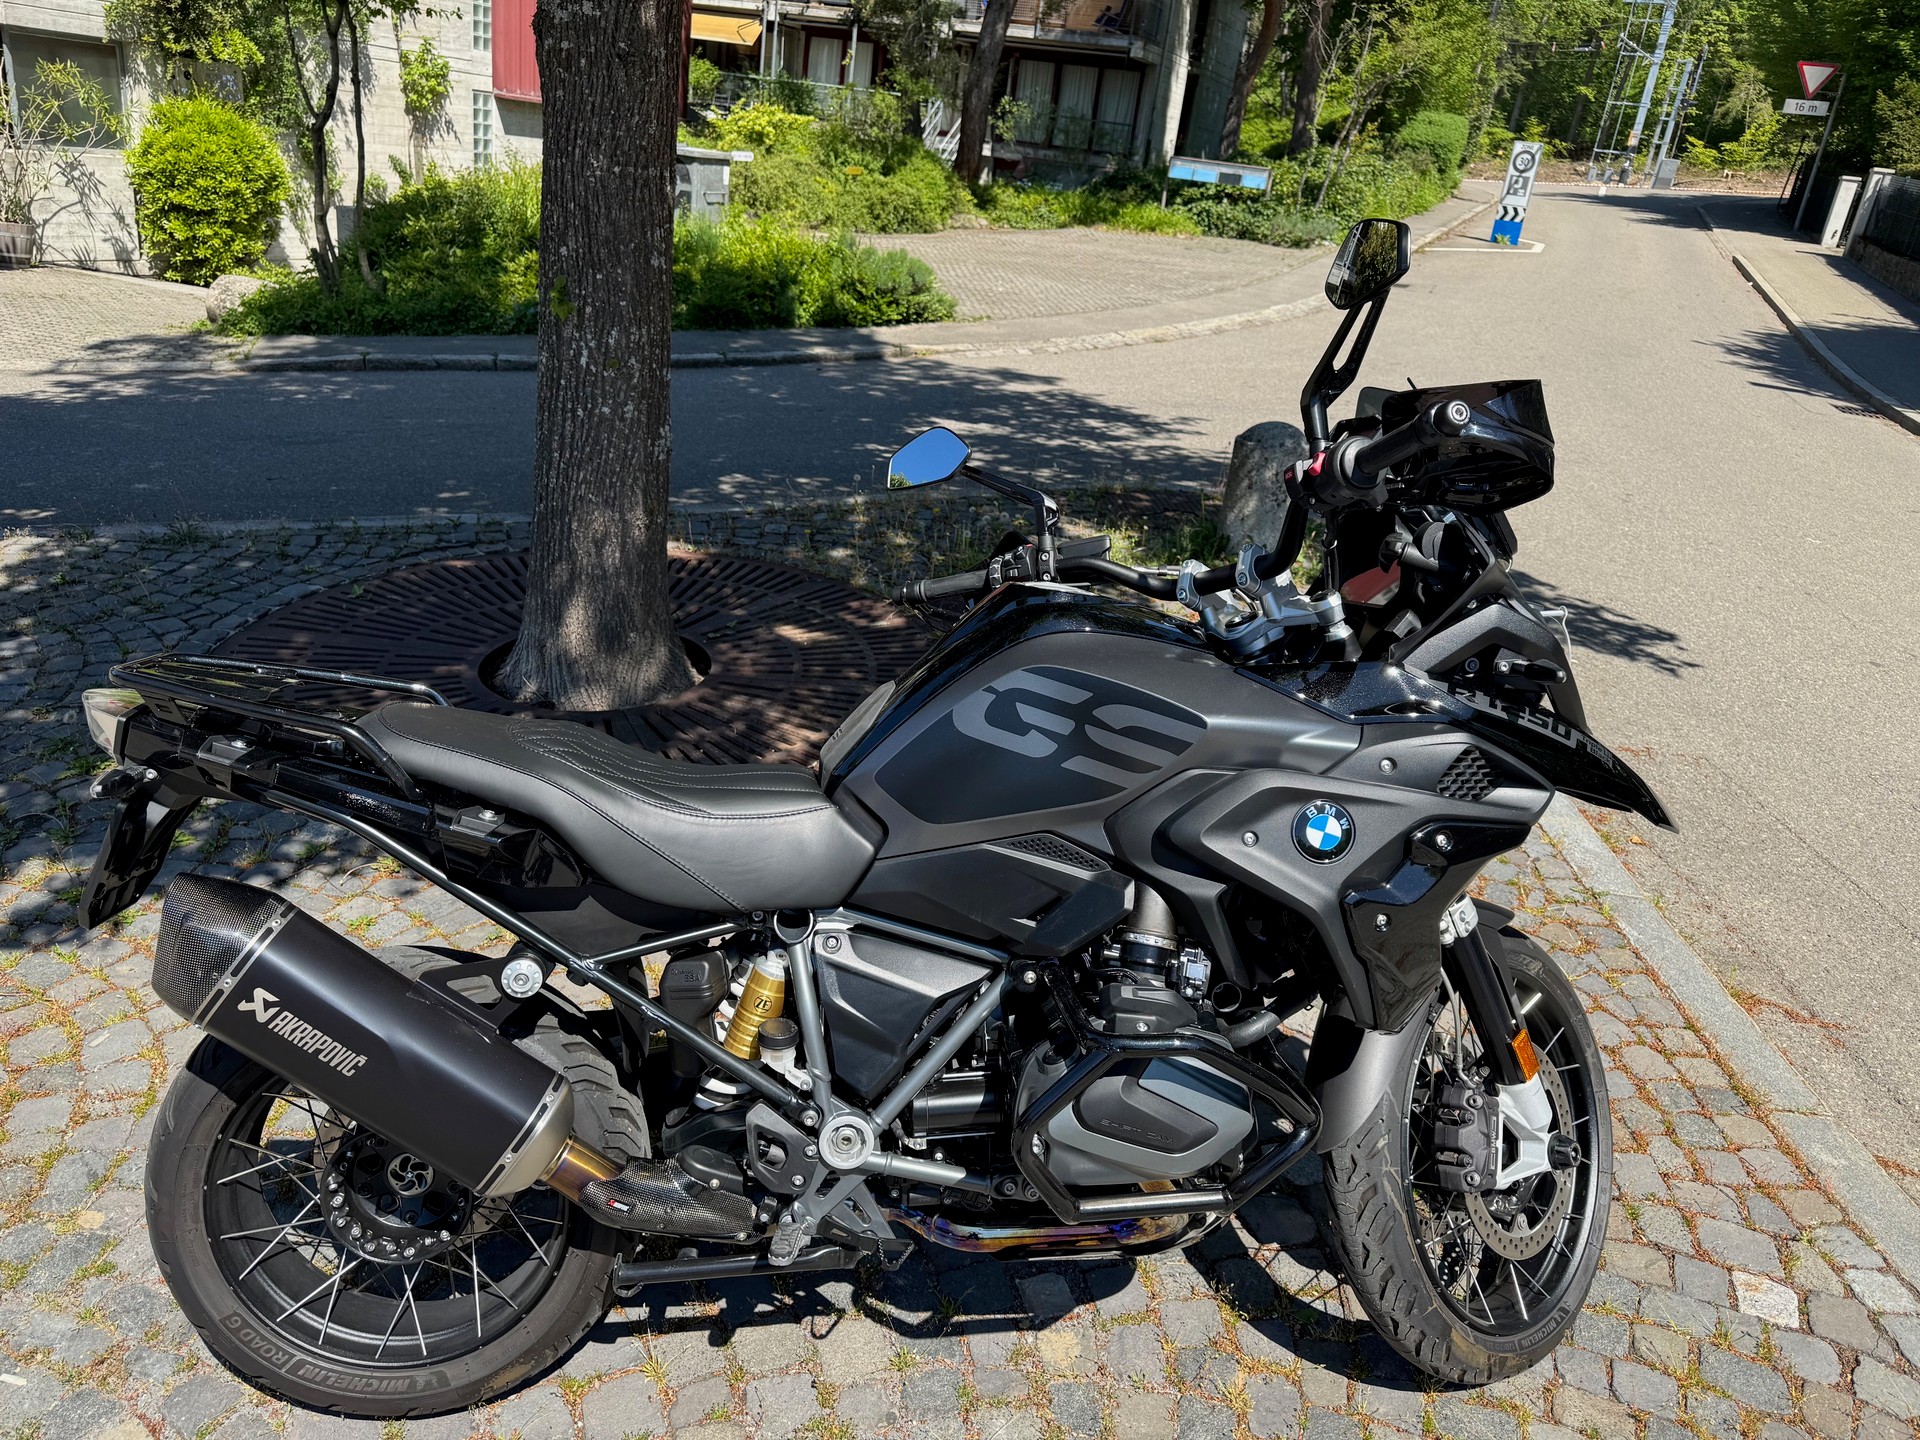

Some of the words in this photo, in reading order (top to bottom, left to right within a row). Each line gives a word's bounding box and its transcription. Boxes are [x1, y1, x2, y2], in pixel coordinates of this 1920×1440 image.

[1794, 102, 1806, 112] 16
[1808, 105, 1818, 113] m
[1518, 157, 1530, 167] 30
[951, 668, 1206, 790] GS
[1305, 804, 1351, 830] BMW
[754, 998, 770, 1010] ZF
[225, 1315, 241, 1328] 6
[1521, 1318, 1557, 1348] MICHELIN
[239, 1330, 289, 1364] ROAD
[297, 1363, 411, 1393] MICHELIN
